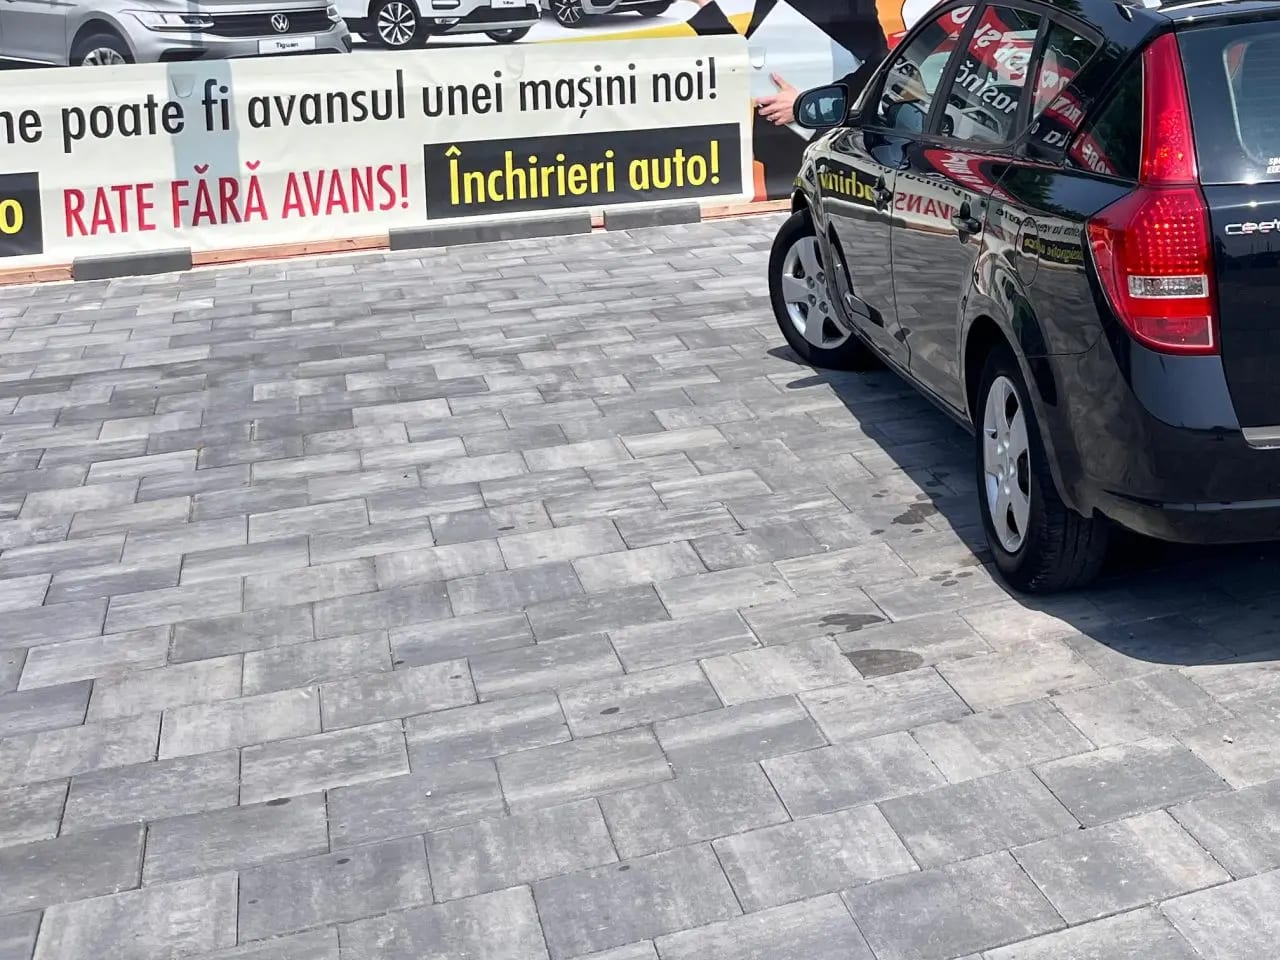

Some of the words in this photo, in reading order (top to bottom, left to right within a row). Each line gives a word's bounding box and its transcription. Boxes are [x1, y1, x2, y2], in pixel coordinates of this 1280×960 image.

[62, 95, 185, 153] poate
[201, 78, 231, 132] fi
[248, 69, 405, 128] avansul
[422, 70, 503, 117] unei
[519, 63, 637, 118] mașini
[652, 56, 718, 103] noi!
[63, 183, 156, 238] RATE
[171, 160, 269, 228] FĂRĂ
[282, 163, 409, 219] AVANS!
[445, 144, 616, 206] Închirieri
[629, 140, 720, 190] auto!
